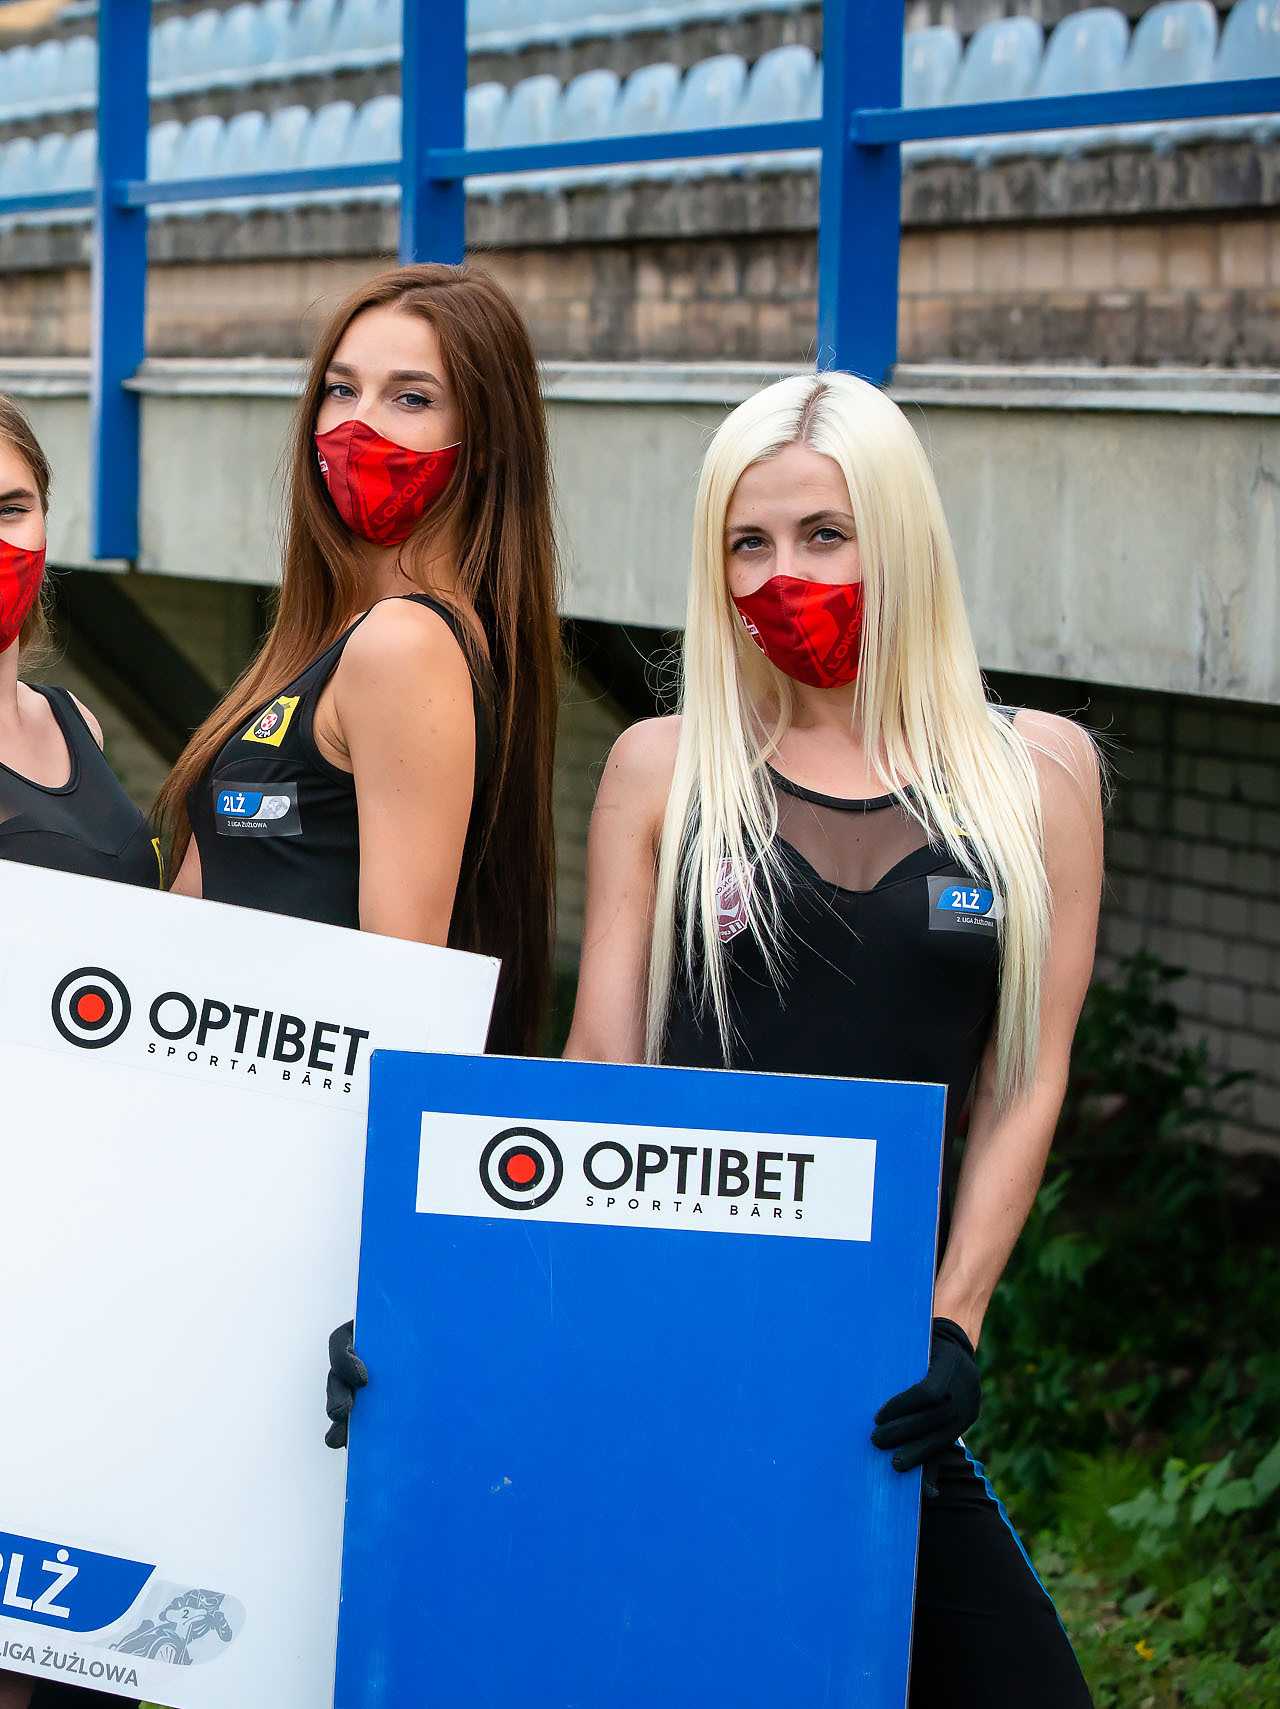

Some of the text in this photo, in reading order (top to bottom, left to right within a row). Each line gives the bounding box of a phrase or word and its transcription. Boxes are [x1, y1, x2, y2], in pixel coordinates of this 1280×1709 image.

[372, 450, 444, 526] LOKOMO
[223, 792, 246, 813] 2LŻ
[951, 888, 980, 910] 2LŻ
[148, 991, 370, 1077] OPTIBET
[147, 1042, 352, 1094] SPORTA BĀRS
[582, 1140, 815, 1203] OPTIBET
[585, 1195, 804, 1221] SPORTA BĀRS
[39, 1644, 140, 1688] ŻUŻLOWA
